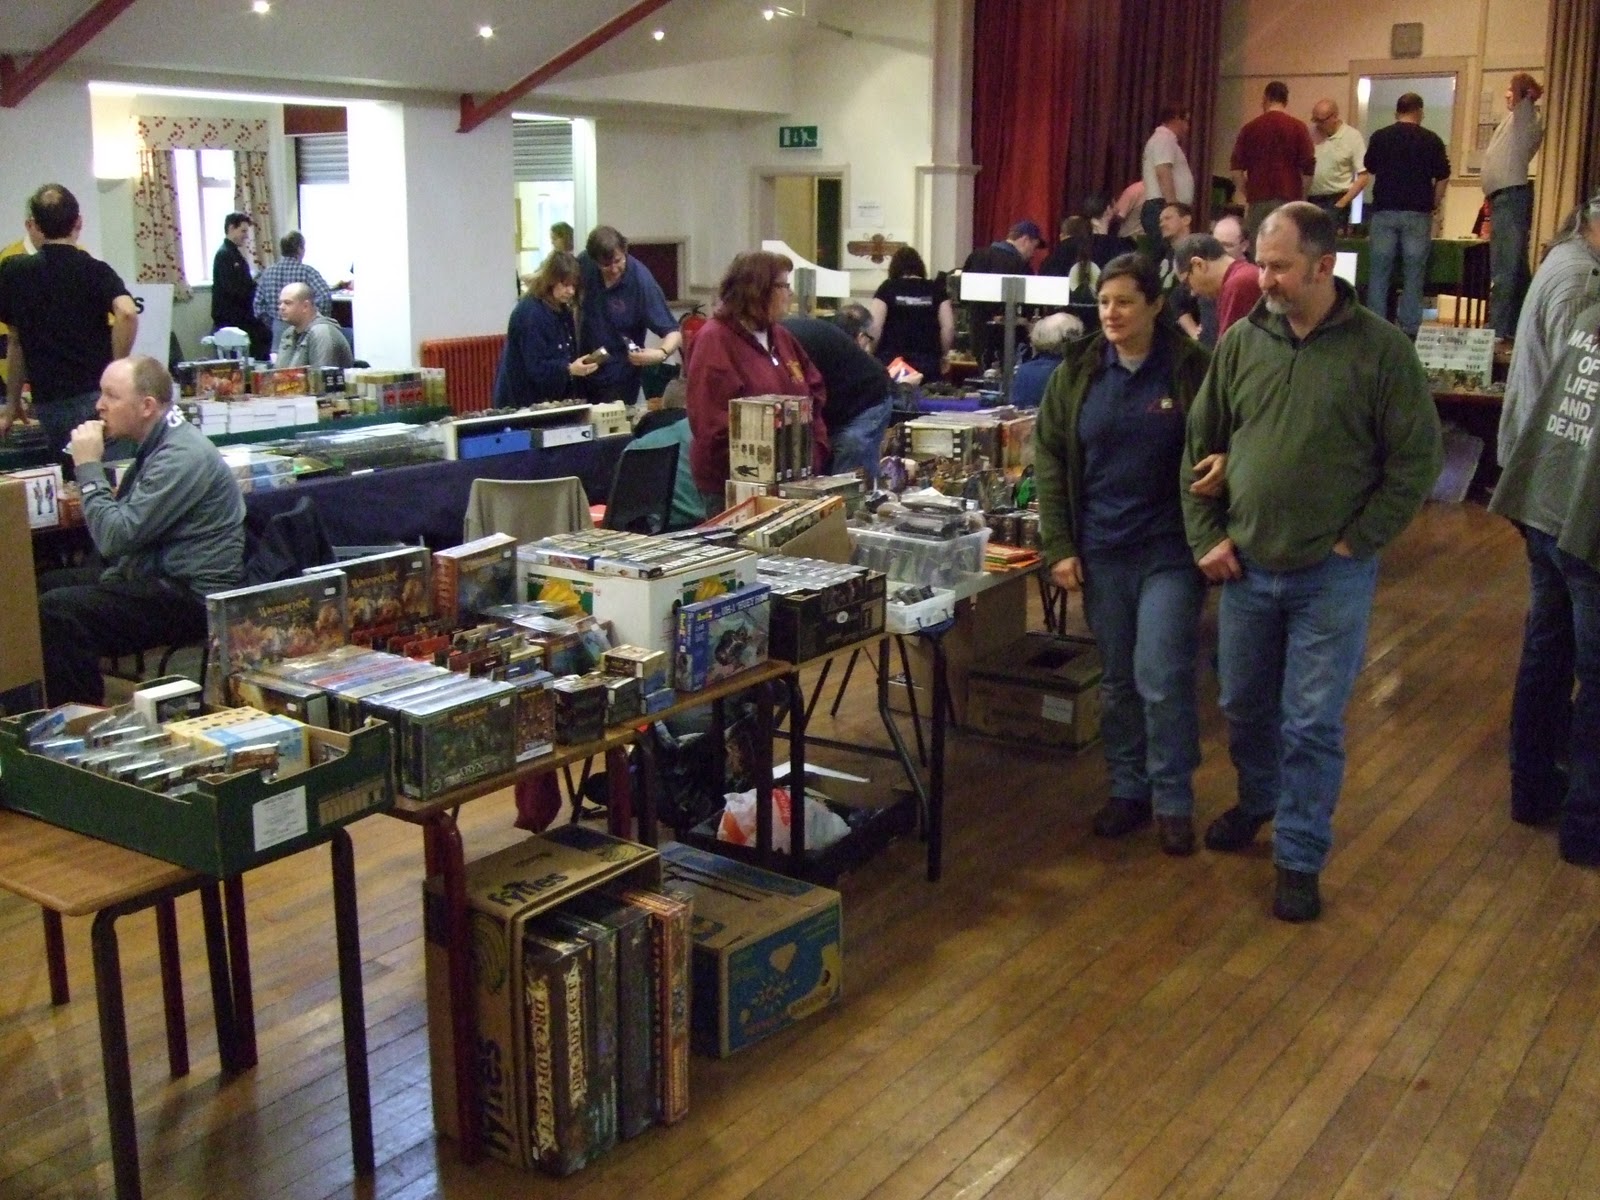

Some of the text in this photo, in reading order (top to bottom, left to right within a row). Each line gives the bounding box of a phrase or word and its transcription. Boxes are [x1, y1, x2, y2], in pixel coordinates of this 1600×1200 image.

[1578, 356, 1600, 375] OF
[1564, 373, 1600, 401] LIFE
[1559, 397, 1591, 421] AND
[1546, 414, 1594, 448] DEATH
